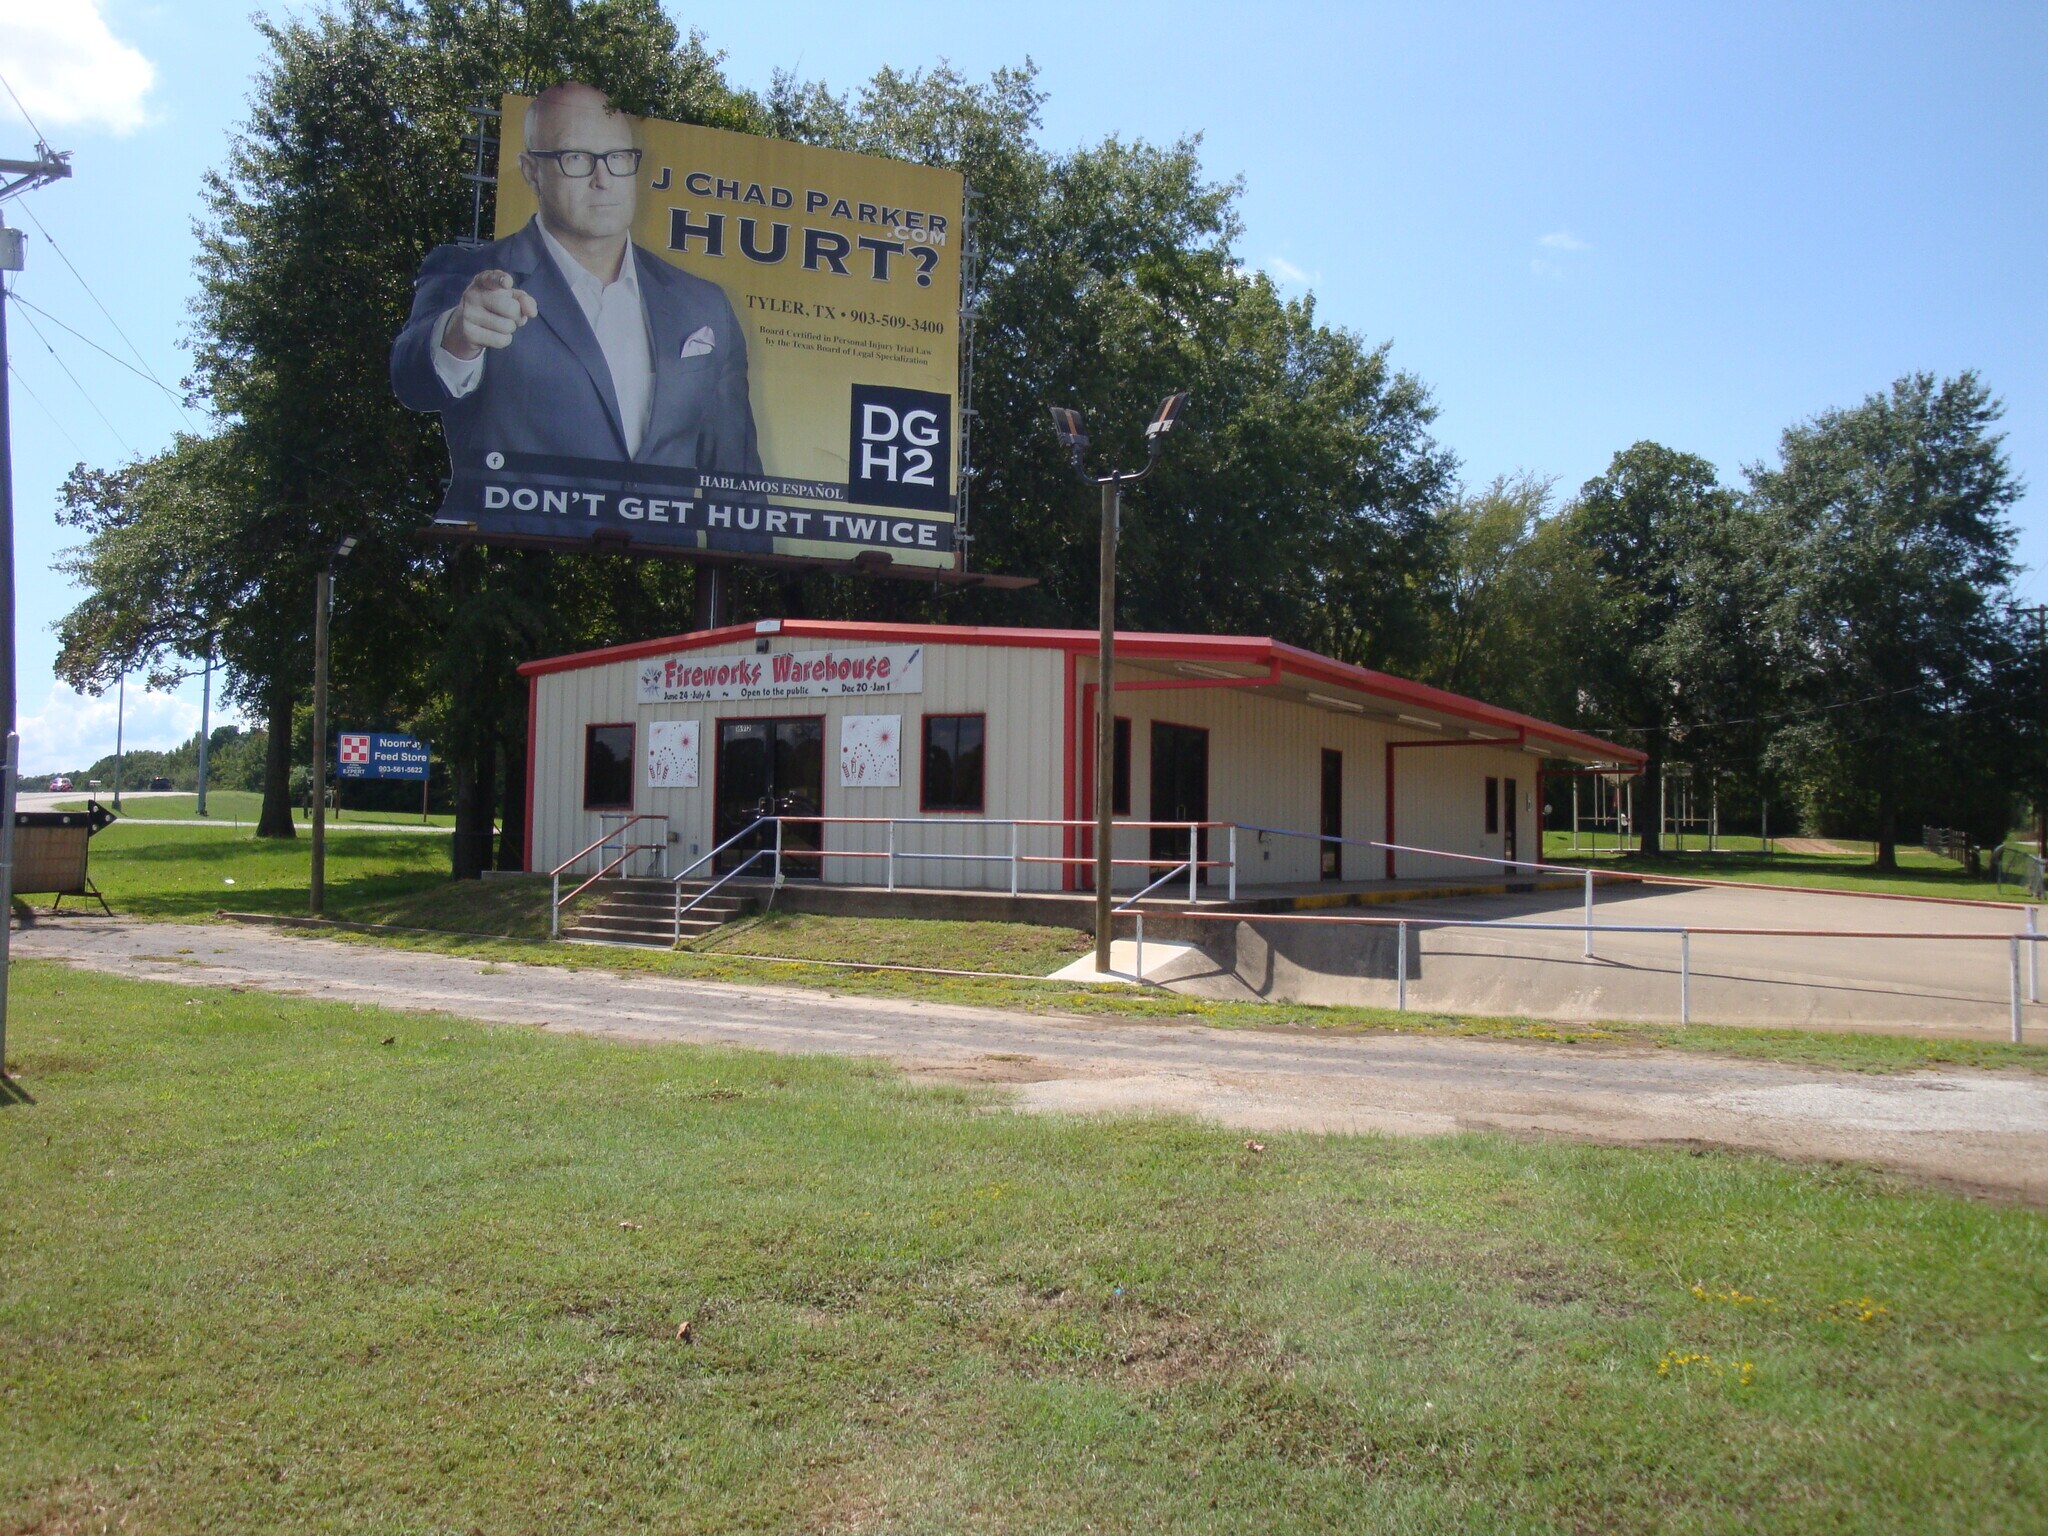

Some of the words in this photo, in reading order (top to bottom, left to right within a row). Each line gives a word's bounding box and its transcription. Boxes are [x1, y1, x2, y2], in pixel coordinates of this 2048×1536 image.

[651, 166, 672, 191] J
[685, 171, 794, 210] CHAD
[805, 190, 949, 235] PARKER
[667, 206, 940, 288] HURT?
[886, 225, 947, 247] .COM
[746, 294, 810, 318] TYLER,
[813, 304, 836, 320] TX
[850, 309, 944, 334] 903-509-3400
[760, 325, 785, 336] Board
[786, 329, 822, 341] Certified
[823, 334, 832, 342] in
[833, 335, 867, 347] Personal
[869, 340, 893, 352] Injury
[895, 344, 914, 353] Trial
[916, 347, 932, 356] Law
[765, 337, 776, 347] by
[777, 338, 791, 347] the
[792, 341, 815, 350] Texas
[816, 344, 841, 354] Board
[842, 347, 851, 355] of
[852, 349, 874, 359] Legal
[875, 352, 928, 365] Specialization
[861, 403, 940, 447] DG
[860, 442, 935, 487] H2
[700, 475, 779, 494] HABLAMOS
[782, 482, 844, 500] ESPAÑOL
[484, 486, 606, 516] DON'T
[618, 497, 694, 524] GET
[708, 504, 812, 535] HURT
[823, 514, 938, 546] TWICE
[664, 658, 763, 689] Fireworks
[772, 652, 892, 684] Warehouse
[679, 691, 689, 700] 24
[706, 689, 711, 699] 4
[741, 687, 761, 700] Open
[763, 687, 771, 696] to
[772, 686, 785, 696] the
[786, 685, 809, 699] public
[841, 683, 855, 693] Dec
[856, 682, 868, 692] 20
[886, 682, 891, 691] 1
[374, 751, 399, 761] Feed
[401, 752, 428, 762] Store
